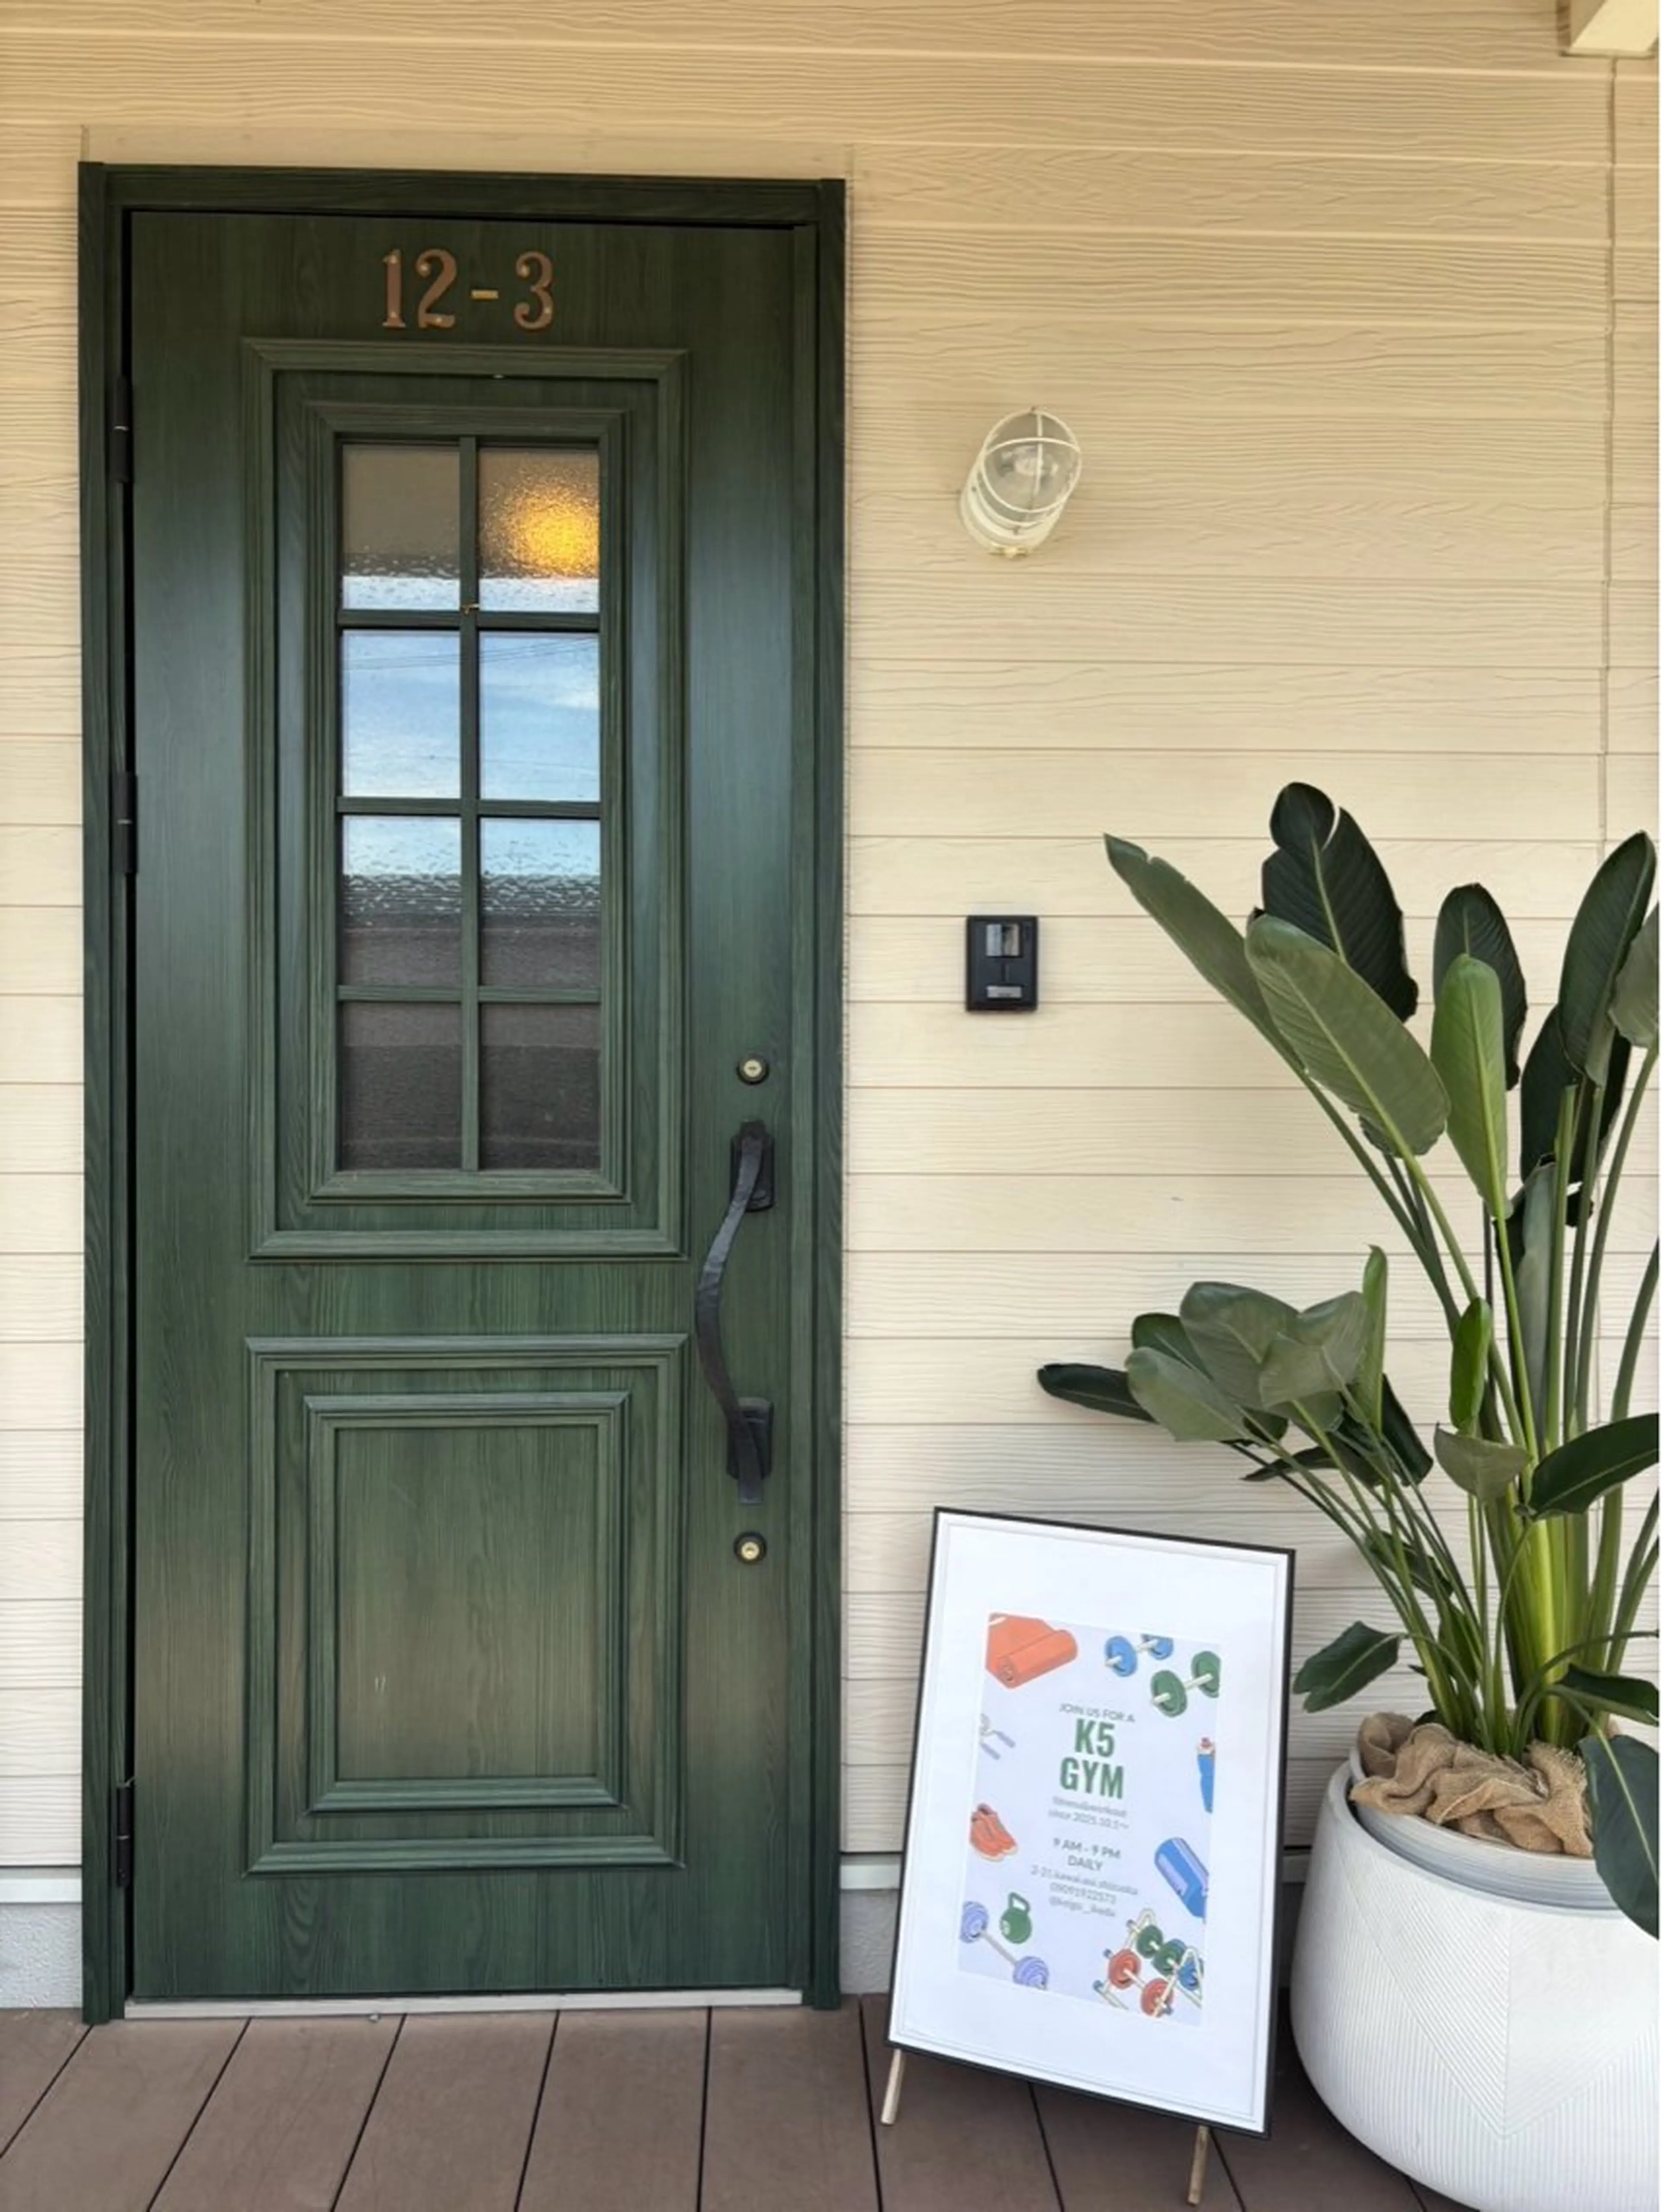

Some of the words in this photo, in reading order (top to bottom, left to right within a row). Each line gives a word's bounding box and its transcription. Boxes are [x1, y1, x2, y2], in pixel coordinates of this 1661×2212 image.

[382, 248, 554, 329] 12-3
[1059, 1703, 1084, 1715] JOIN
[1086, 1707, 1100, 1718] US
[1102, 1709, 1125, 1721] FOR
[1127, 1714, 1135, 1723] A
[1074, 1718, 1115, 1757] K5
[1060, 1757, 1124, 1798] GYM
[1061, 1840, 1082, 1852] AM
[1101, 1846, 1121, 1859] PM
[1068, 1855, 1103, 1871] DAILY
